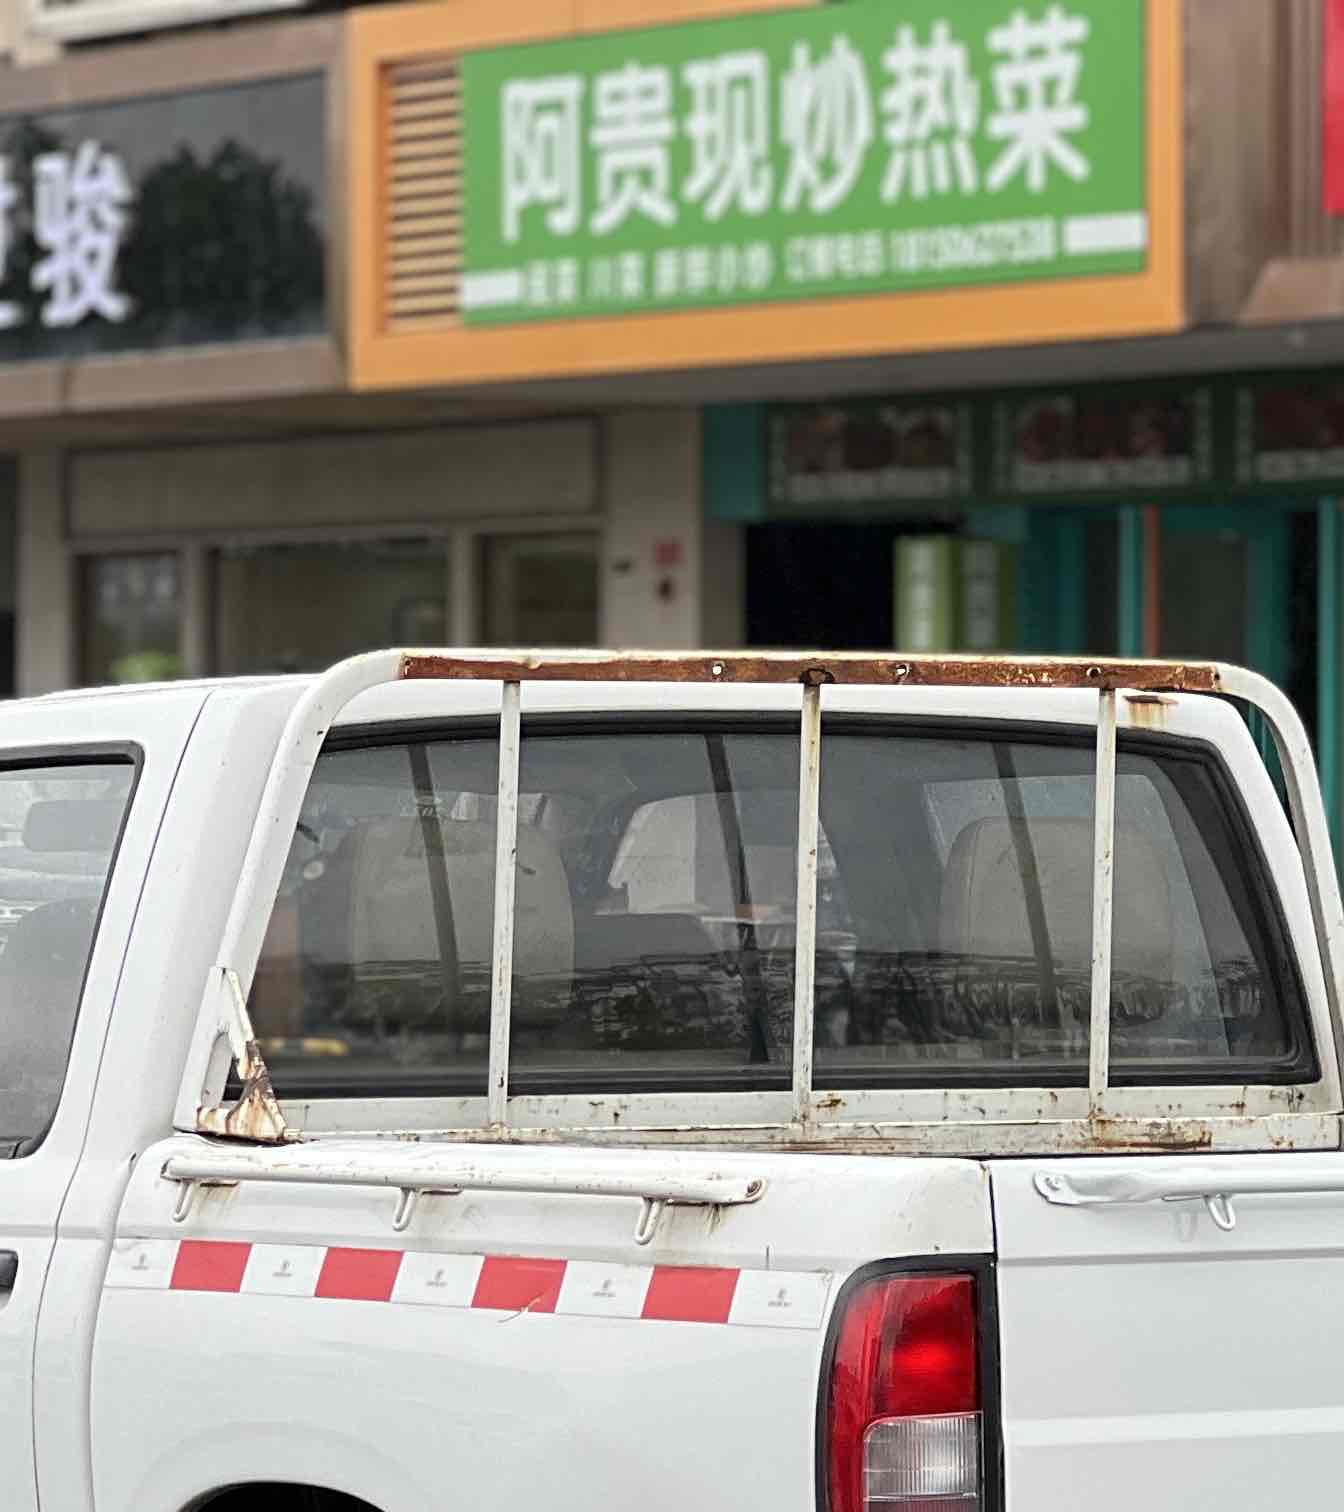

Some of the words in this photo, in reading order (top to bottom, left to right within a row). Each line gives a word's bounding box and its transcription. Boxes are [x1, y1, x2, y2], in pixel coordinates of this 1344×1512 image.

[500, 8, 1092, 243] 阿贵现炒热菜
